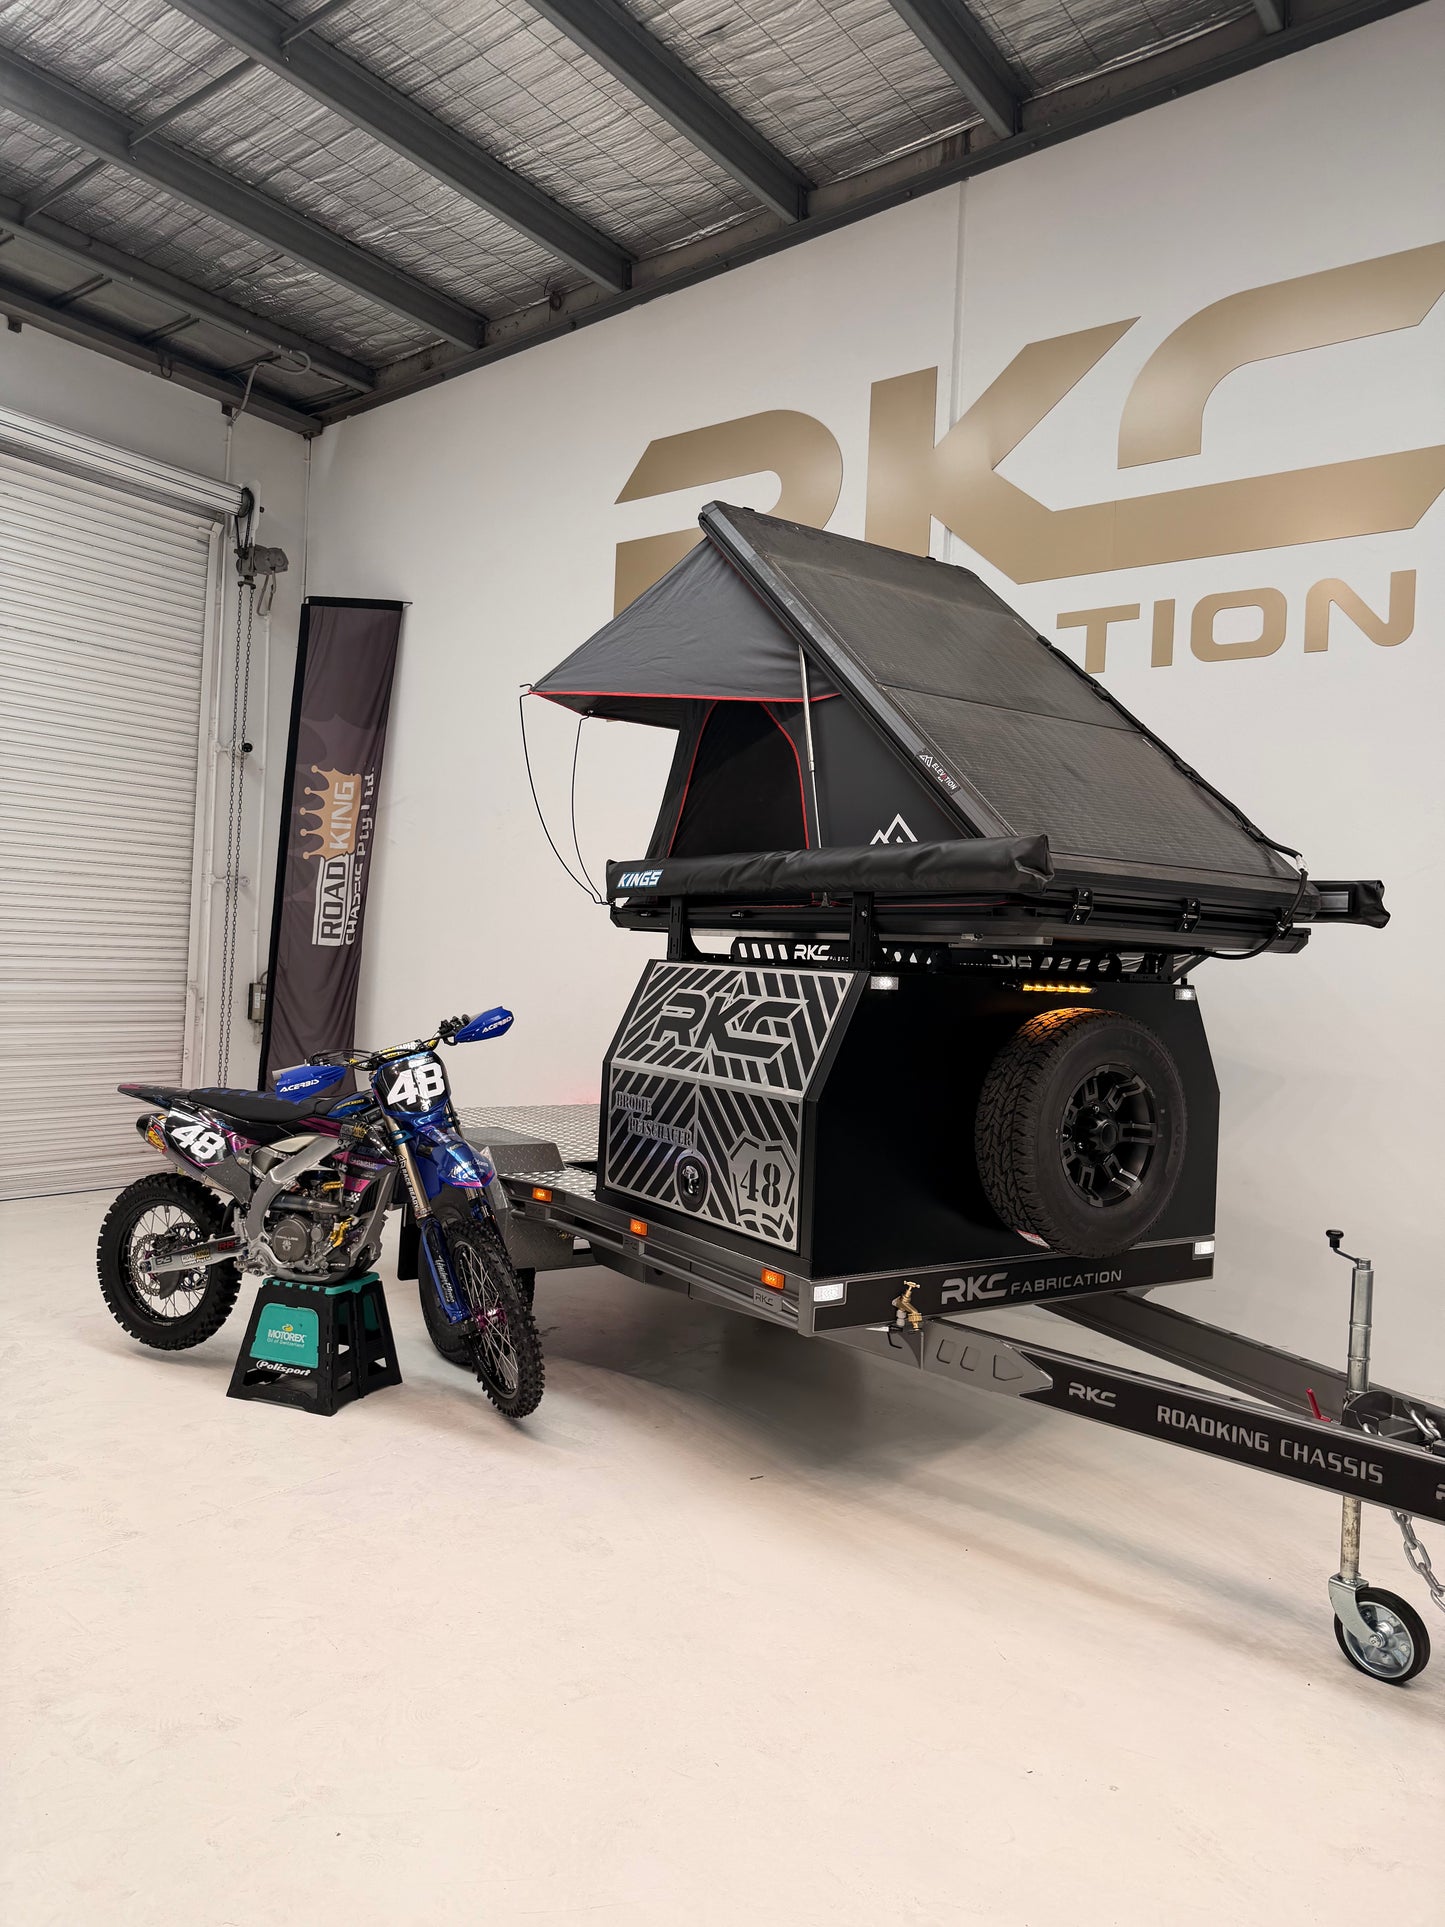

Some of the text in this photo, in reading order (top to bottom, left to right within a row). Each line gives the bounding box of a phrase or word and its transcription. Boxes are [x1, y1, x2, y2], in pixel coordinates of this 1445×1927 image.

[320, 781, 355, 940] ROAD KING
[616, 869, 664, 888] KINGS
[793, 943, 831, 961] RKC
[650, 990, 803, 1060] RKC
[386, 1062, 446, 1106] 48
[170, 1124, 226, 1160] 48
[739, 1159, 781, 1208] 48
[941, 1269, 1123, 1305] RKC FABRICATION
[268, 1330, 305, 1343] MOTOREX
[257, 1360, 311, 1376] Polisport
[1068, 1381, 1385, 1486] RKC ROADKING CHASSIS
